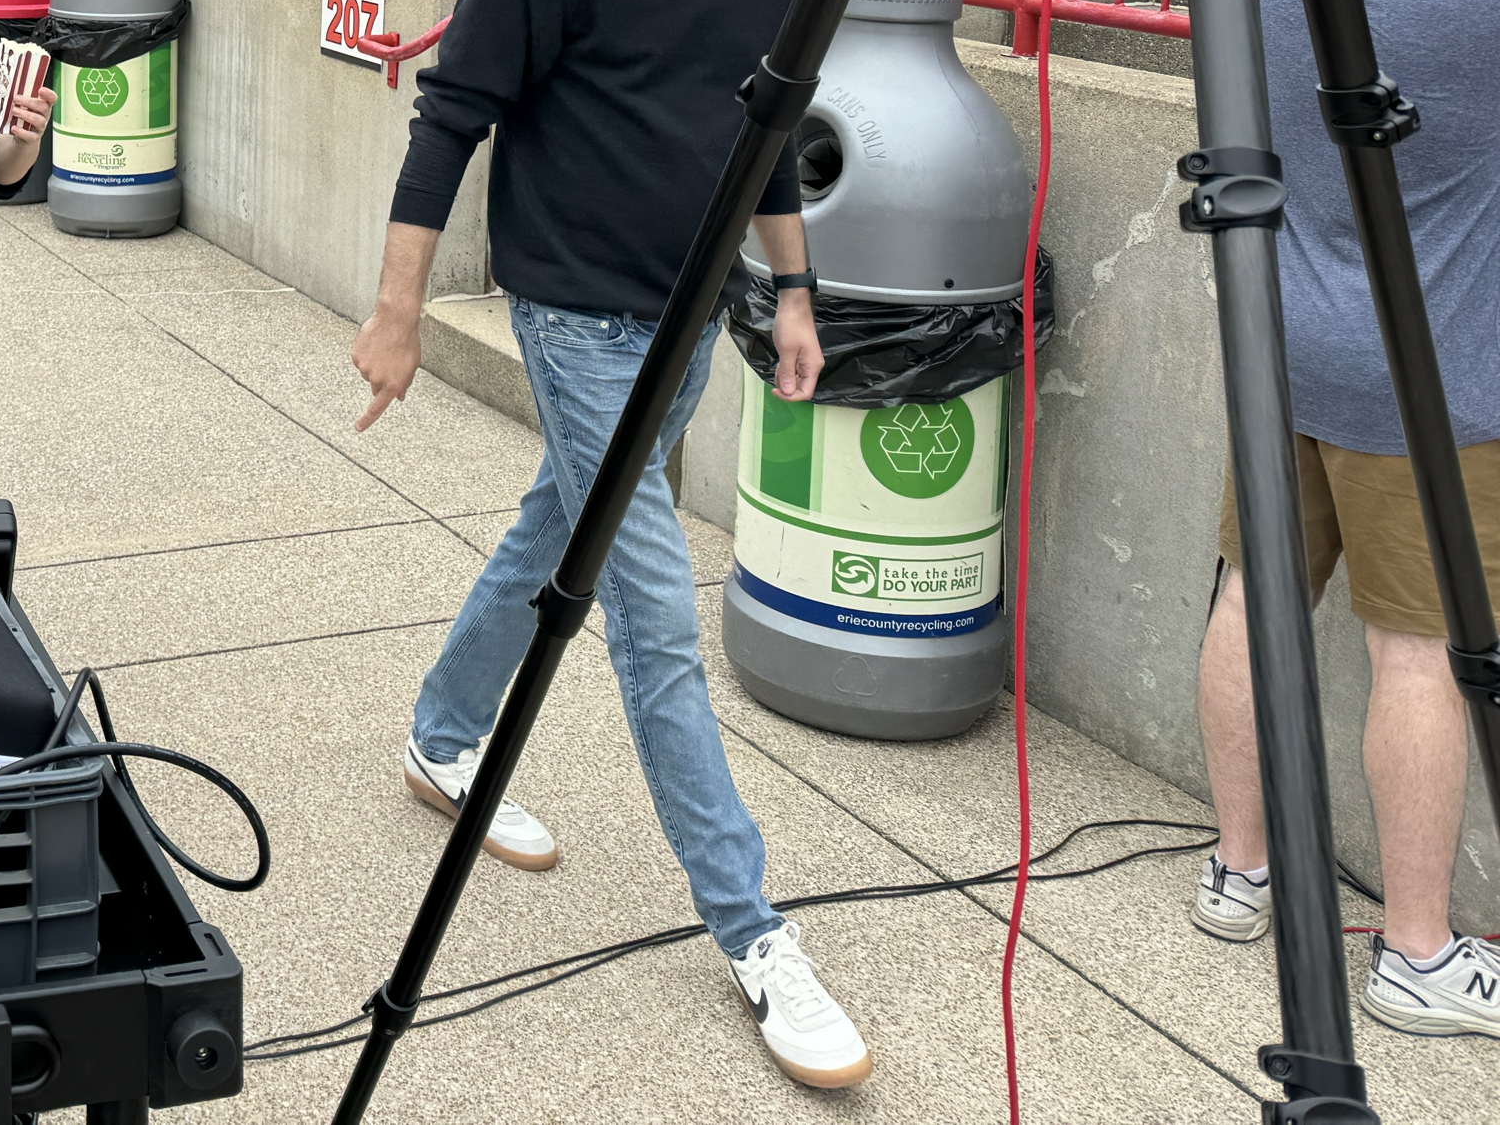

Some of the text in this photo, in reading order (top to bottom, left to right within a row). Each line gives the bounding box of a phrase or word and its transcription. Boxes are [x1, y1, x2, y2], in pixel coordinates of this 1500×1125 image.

[826, 86, 888, 160] CANS ONLY
[77, 152, 126, 167] Recycling
[884, 564, 979, 580] take the time
[883, 576, 978, 593] DO YOUR PART
[837, 613, 975, 633] eriecountyrecycling.com
